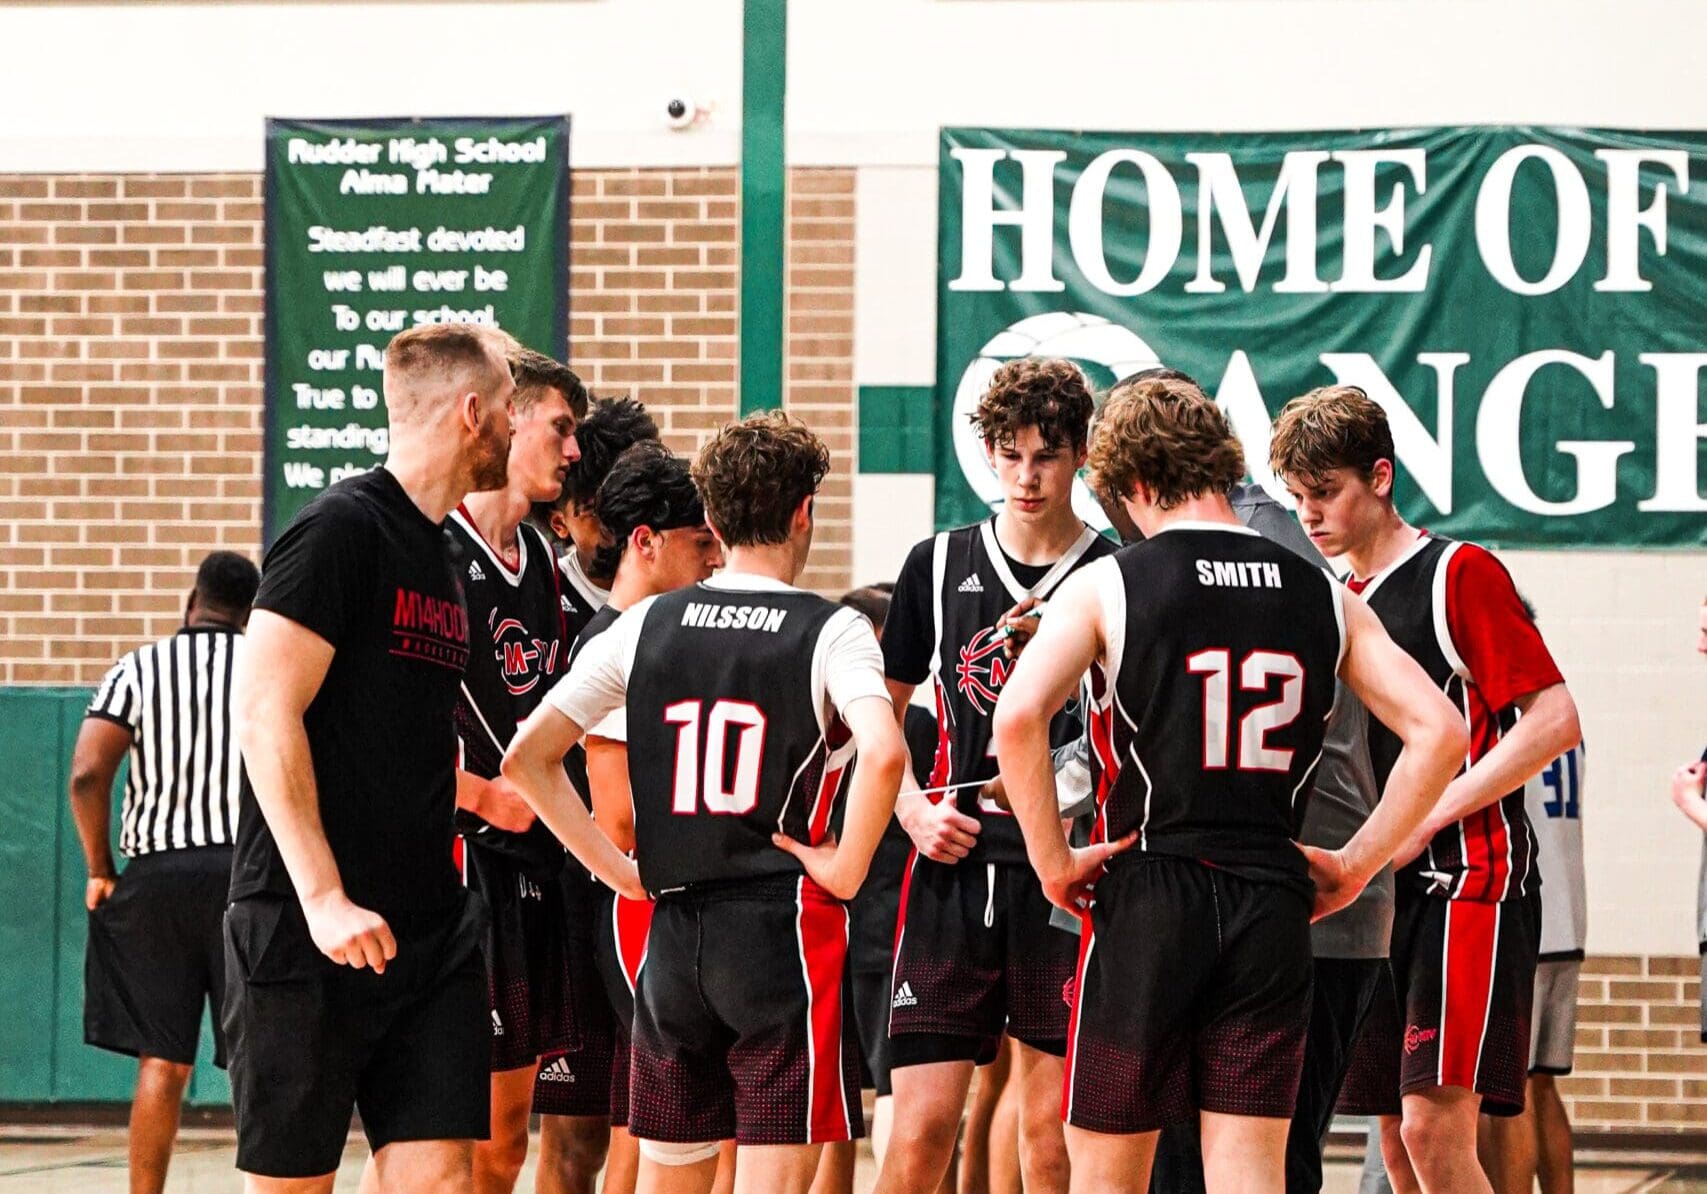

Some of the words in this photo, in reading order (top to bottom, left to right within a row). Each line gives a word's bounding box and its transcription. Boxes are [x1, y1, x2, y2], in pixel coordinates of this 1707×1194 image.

[288, 138, 383, 164] Rudder
[389, 137, 447, 171] High
[455, 136, 547, 163] School
[340, 169, 408, 194] Alma
[416, 168, 493, 194] Mater
[948, 146, 1433, 297] HOME
[1475, 144, 1690, 297] OF
[308, 226, 422, 252] Steadfast
[427, 225, 525, 252] devoted
[323, 270, 363, 292] we
[368, 266, 407, 292] will
[412, 270, 470, 292] ever
[474, 265, 509, 292] be
[331, 304, 361, 332] To
[365, 309, 409, 332] our
[307, 349, 350, 371] our
[291, 383, 346, 410] True
[351, 384, 379, 410] to
[286, 423, 389, 454] standing
[283, 462, 325, 489] We
[1196, 560, 1282, 589] SMITH
[680, 602, 788, 633] NILSSON
[1187, 647, 1306, 773] 12
[664, 698, 768, 816] 10
[1542, 747, 1580, 819] 31
